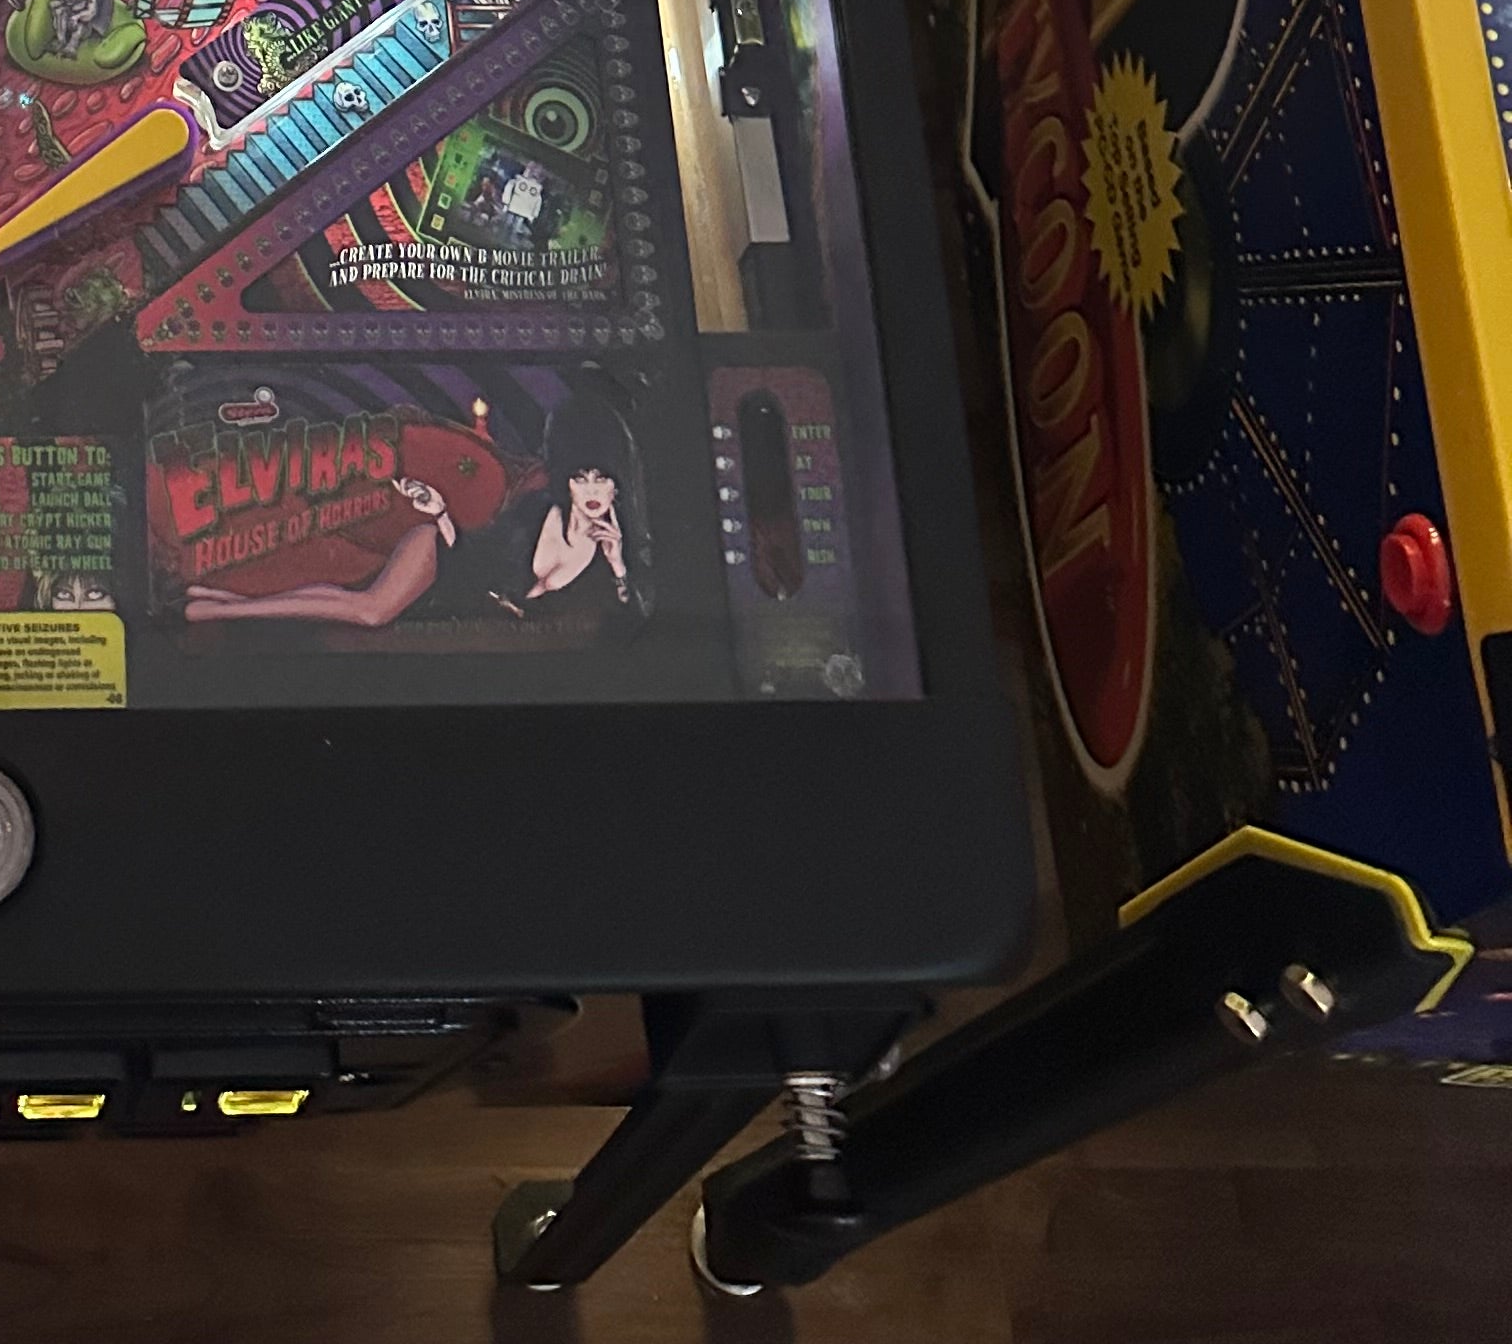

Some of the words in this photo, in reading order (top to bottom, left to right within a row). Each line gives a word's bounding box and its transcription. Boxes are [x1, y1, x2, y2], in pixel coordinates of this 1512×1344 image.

[398, 242, 436, 262] YOUR
[438, 244, 473, 263] OWN
[478, 246, 488, 264] B
[491, 248, 536, 268] MOVIE
[328, 264, 359, 288] AND
[362, 261, 426, 281] PREPARE
[429, 262, 456, 282] FOR
[459, 265, 488, 285] THE
[490, 267, 555, 287] CRITICAL
[791, 425, 832, 440] ENTER
[12, 445, 79, 466] BUTTON
[84, 445, 112, 466] TO:
[31, 472, 73, 487] START
[77, 472, 112, 487] GAME
[31, 491, 80, 507] LAUNCH
[84, 491, 112, 507] BALL
[20, 512, 63, 528] CRYPT
[66, 512, 112, 528] KICKER
[194, 519, 279, 576] HOUSE
[283, 509, 313, 543] OF
[318, 489, 389, 529] HORRORS
[5, 534, 53, 551] ATOMIC
[56, 534, 82, 551] RAY
[86, 534, 112, 551] GUN
[70, 555, 113, 571] WHEEL
[24, 623, 80, 633] SEIZURES
